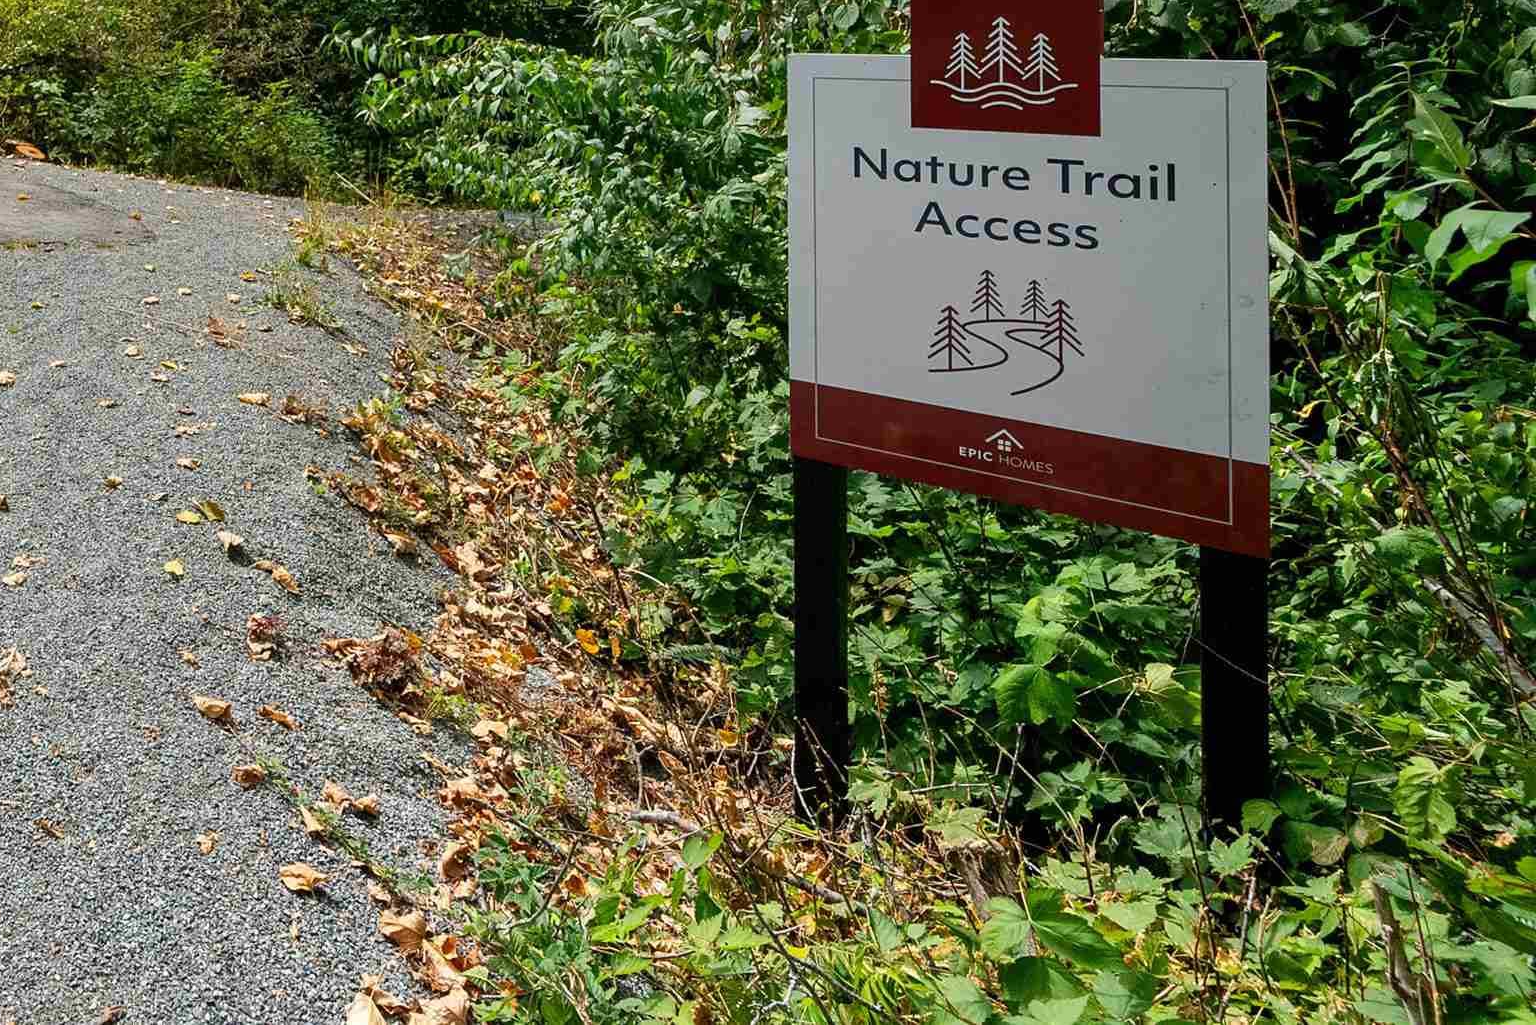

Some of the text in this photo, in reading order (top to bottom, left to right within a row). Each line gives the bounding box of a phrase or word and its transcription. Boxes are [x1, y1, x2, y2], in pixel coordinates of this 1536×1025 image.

[853, 146, 1177, 202] Nature Trail
[914, 201, 1099, 250] Access
[959, 446, 1054, 475] EPIC HOMES
